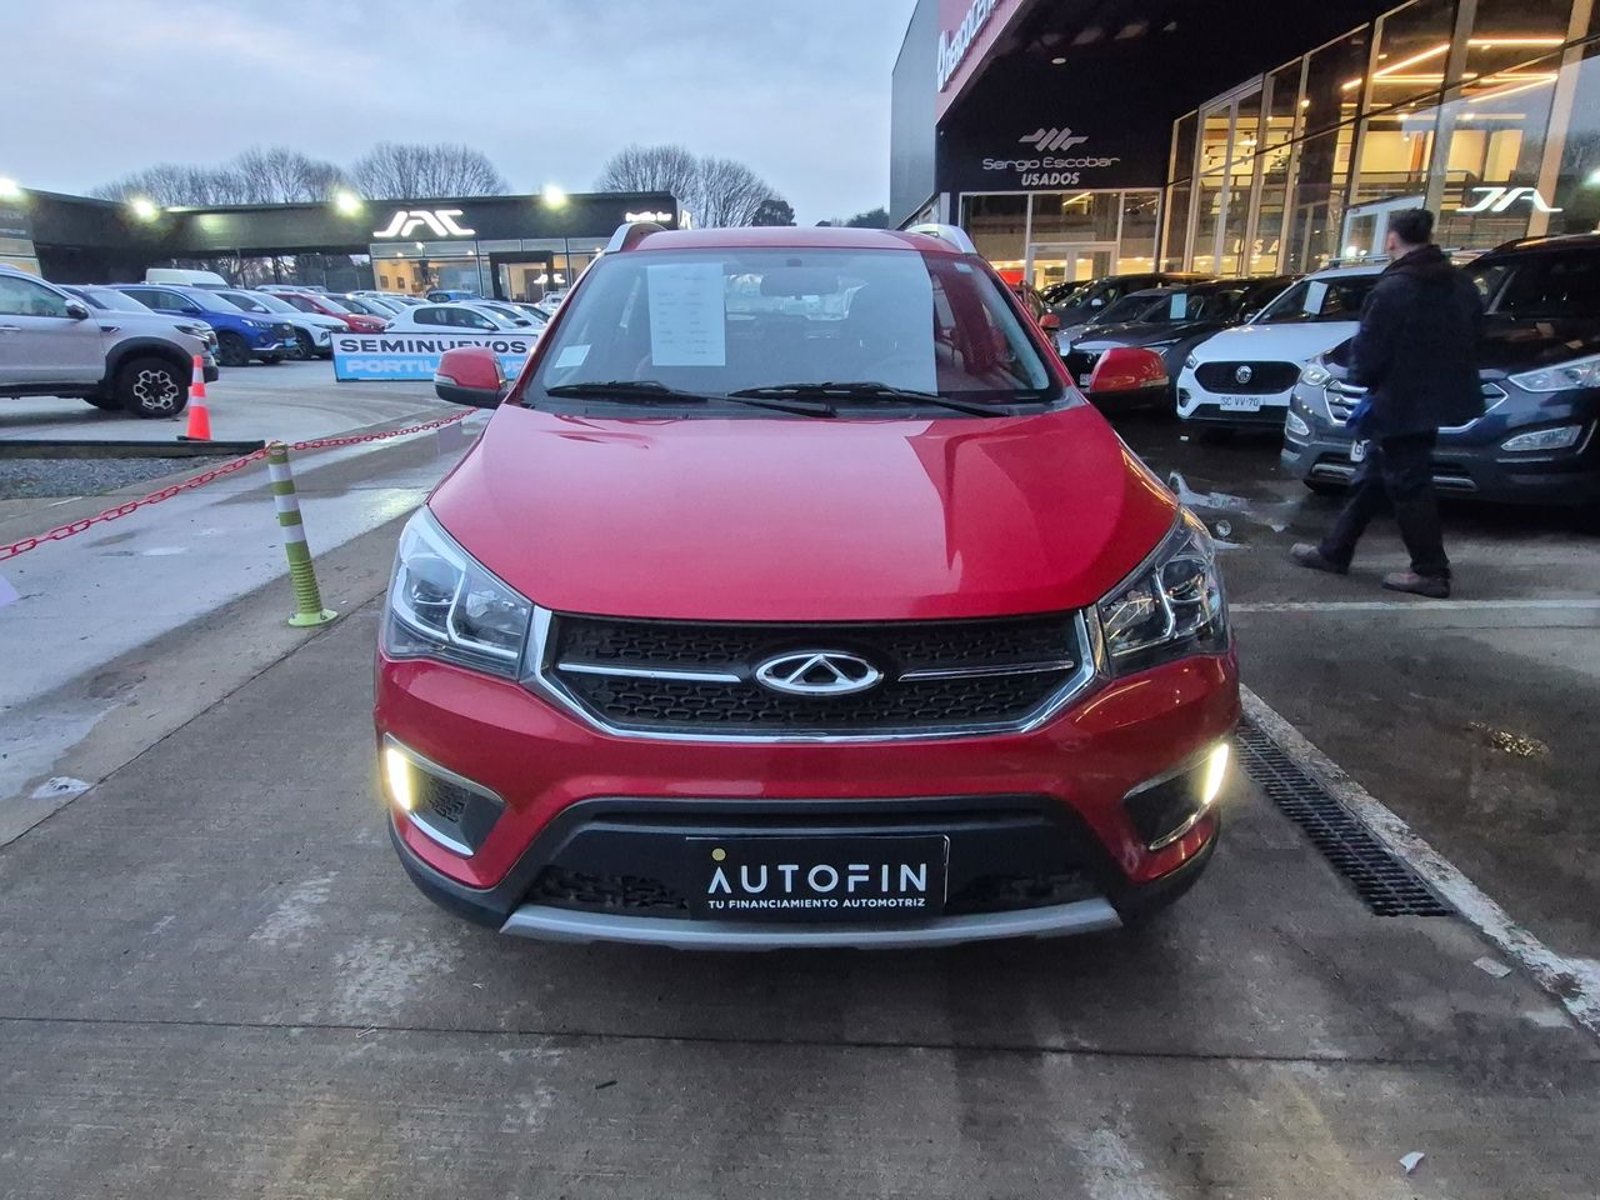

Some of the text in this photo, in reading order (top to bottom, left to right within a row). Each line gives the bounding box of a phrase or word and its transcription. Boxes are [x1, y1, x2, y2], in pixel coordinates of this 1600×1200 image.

[982, 156, 1120, 172] Sergo Escobar
[1021, 172, 1080, 186] USADOS
[373, 210, 476, 237] JAC
[346, 359, 437, 373] PORTIL
[708, 863, 927, 893] AUTOFIN
[708, 897, 926, 909] TU FINANCIAMIENTO AUTOMOTRIZ
